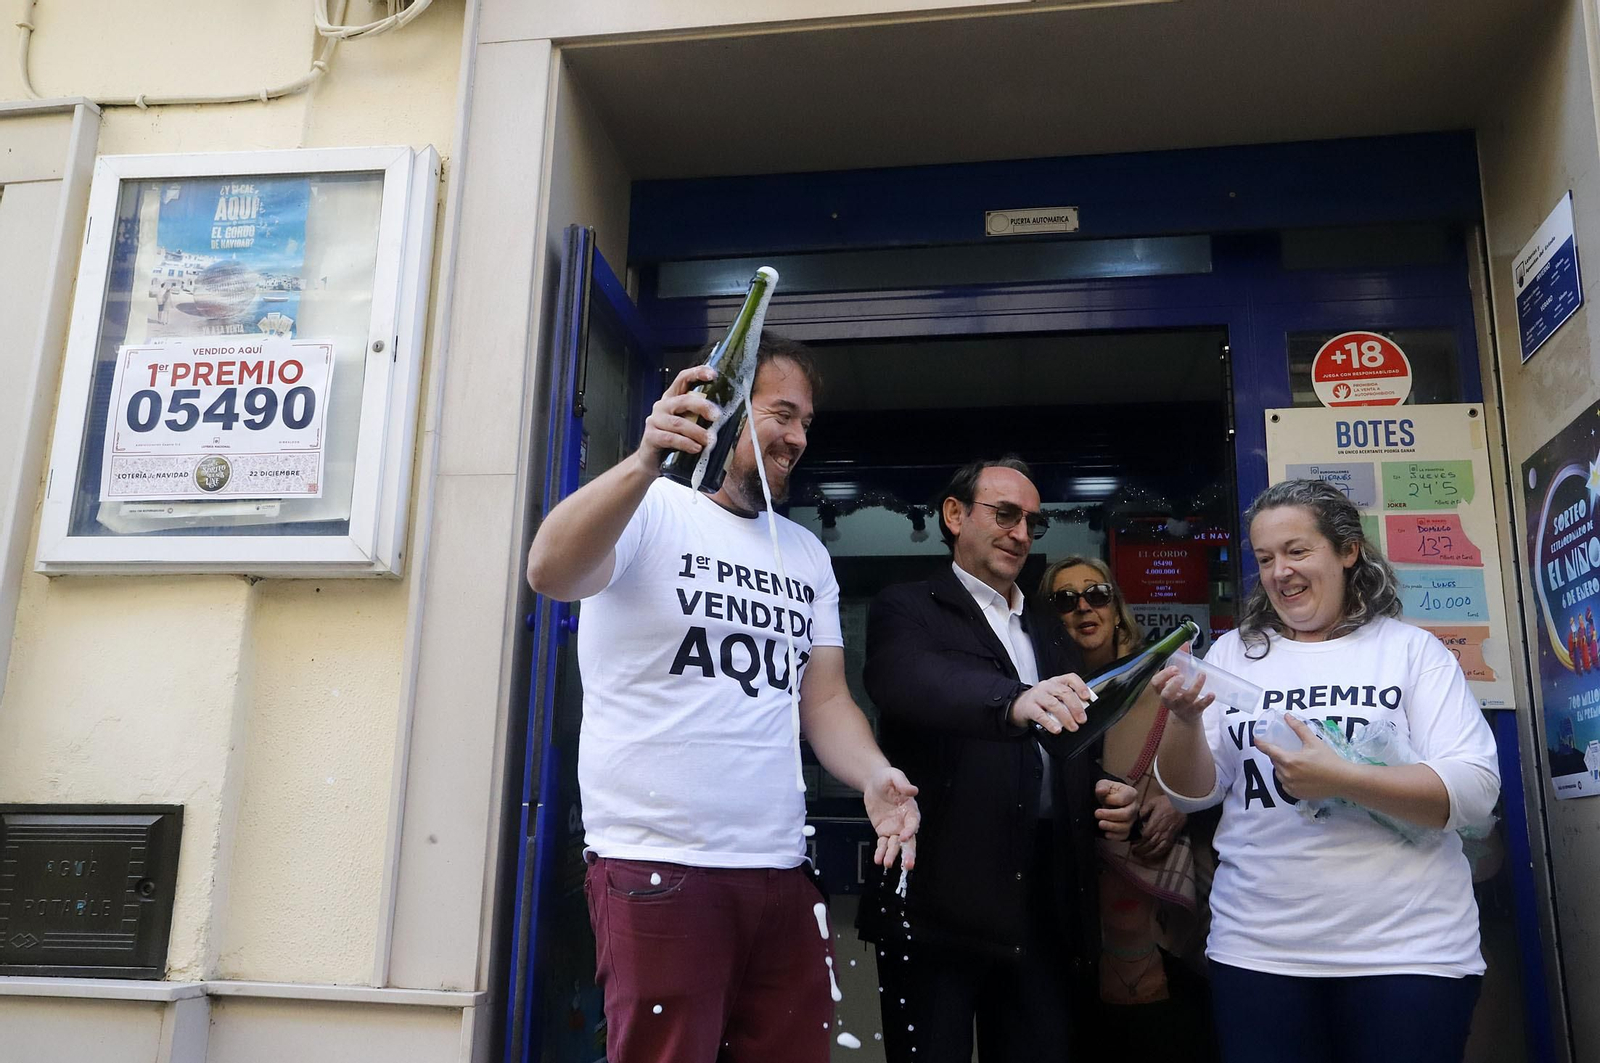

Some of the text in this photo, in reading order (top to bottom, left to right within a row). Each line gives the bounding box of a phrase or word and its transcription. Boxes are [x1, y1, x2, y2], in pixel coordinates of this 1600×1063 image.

[214, 189, 260, 220] AQUÍ
[211, 225, 255, 239] EL GORDO
[1032, 216, 1069, 224] AUTOMATICA
[210, 239, 220, 250] DE
[238, 345, 263, 354] AQUÍ
[1331, 340, 1385, 368] +18
[148, 359, 304, 387] 1er PREMIO
[126, 386, 316, 432] 05490
[1336, 419, 1414, 448] BOTES
[118, 470, 147, 479] LOTERÍA
[1553, 499, 1586, 536] SORTEO
[1551, 520, 1593, 554] EXTRAORDINARIO DE
[1548, 536, 1600, 591] EL NIÑO
[678, 553, 815, 605] 1er PREMIO
[1562, 577, 1600, 609] 6 DE ENERO
[1419, 591, 1471, 610] 10.000
[1263, 685, 1402, 710] PREMIO
[25, 900, 111, 915] POTABLE
